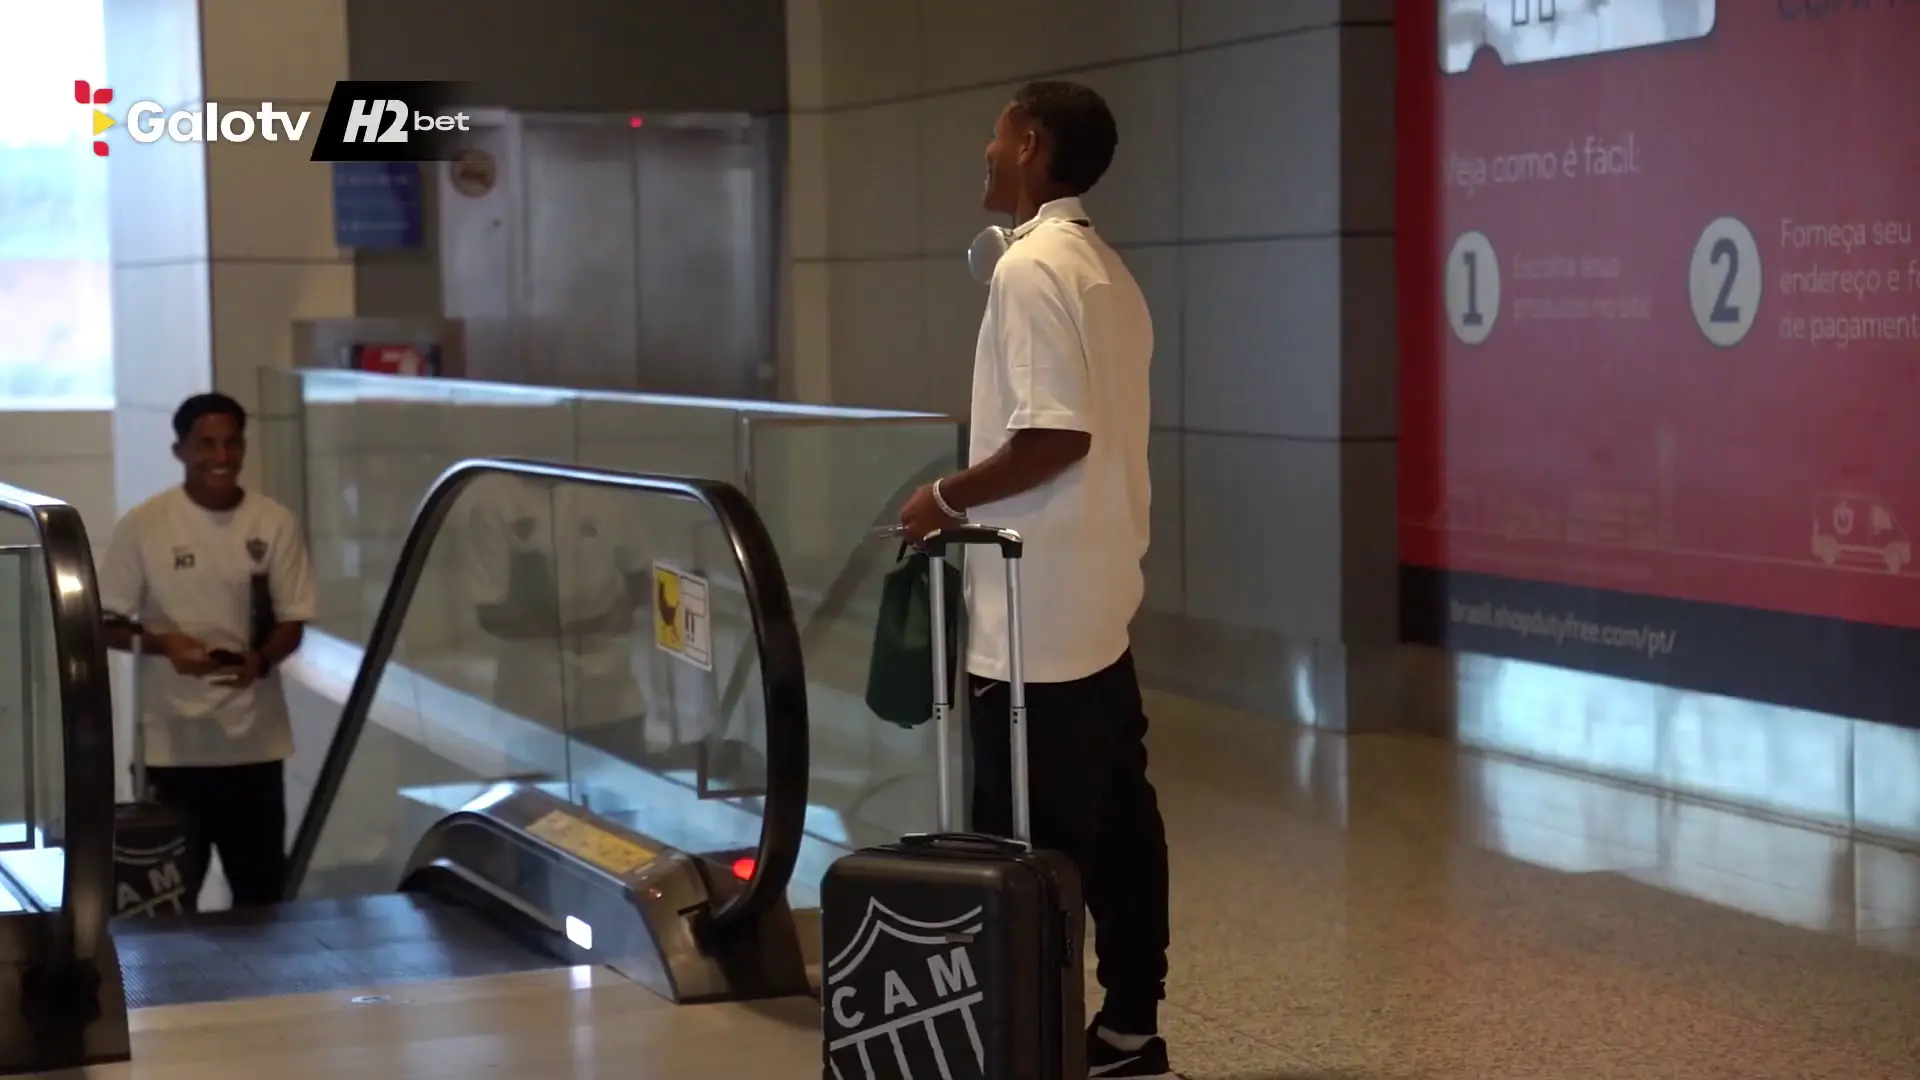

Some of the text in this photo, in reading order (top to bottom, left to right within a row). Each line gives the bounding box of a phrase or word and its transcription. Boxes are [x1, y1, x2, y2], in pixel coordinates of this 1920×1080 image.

[1493, 151, 1557, 183] como
[1563, 137, 1578, 179] é
[1780, 218, 1911, 254] Forneça seu
[1463, 251, 1482, 326] 1
[1710, 237, 1740, 322] 2
[1780, 260, 1920, 299] endereço e f
[1779, 311, 1805, 340] de
[117, 862, 181, 911] AM
[831, 946, 977, 1029] CAM
